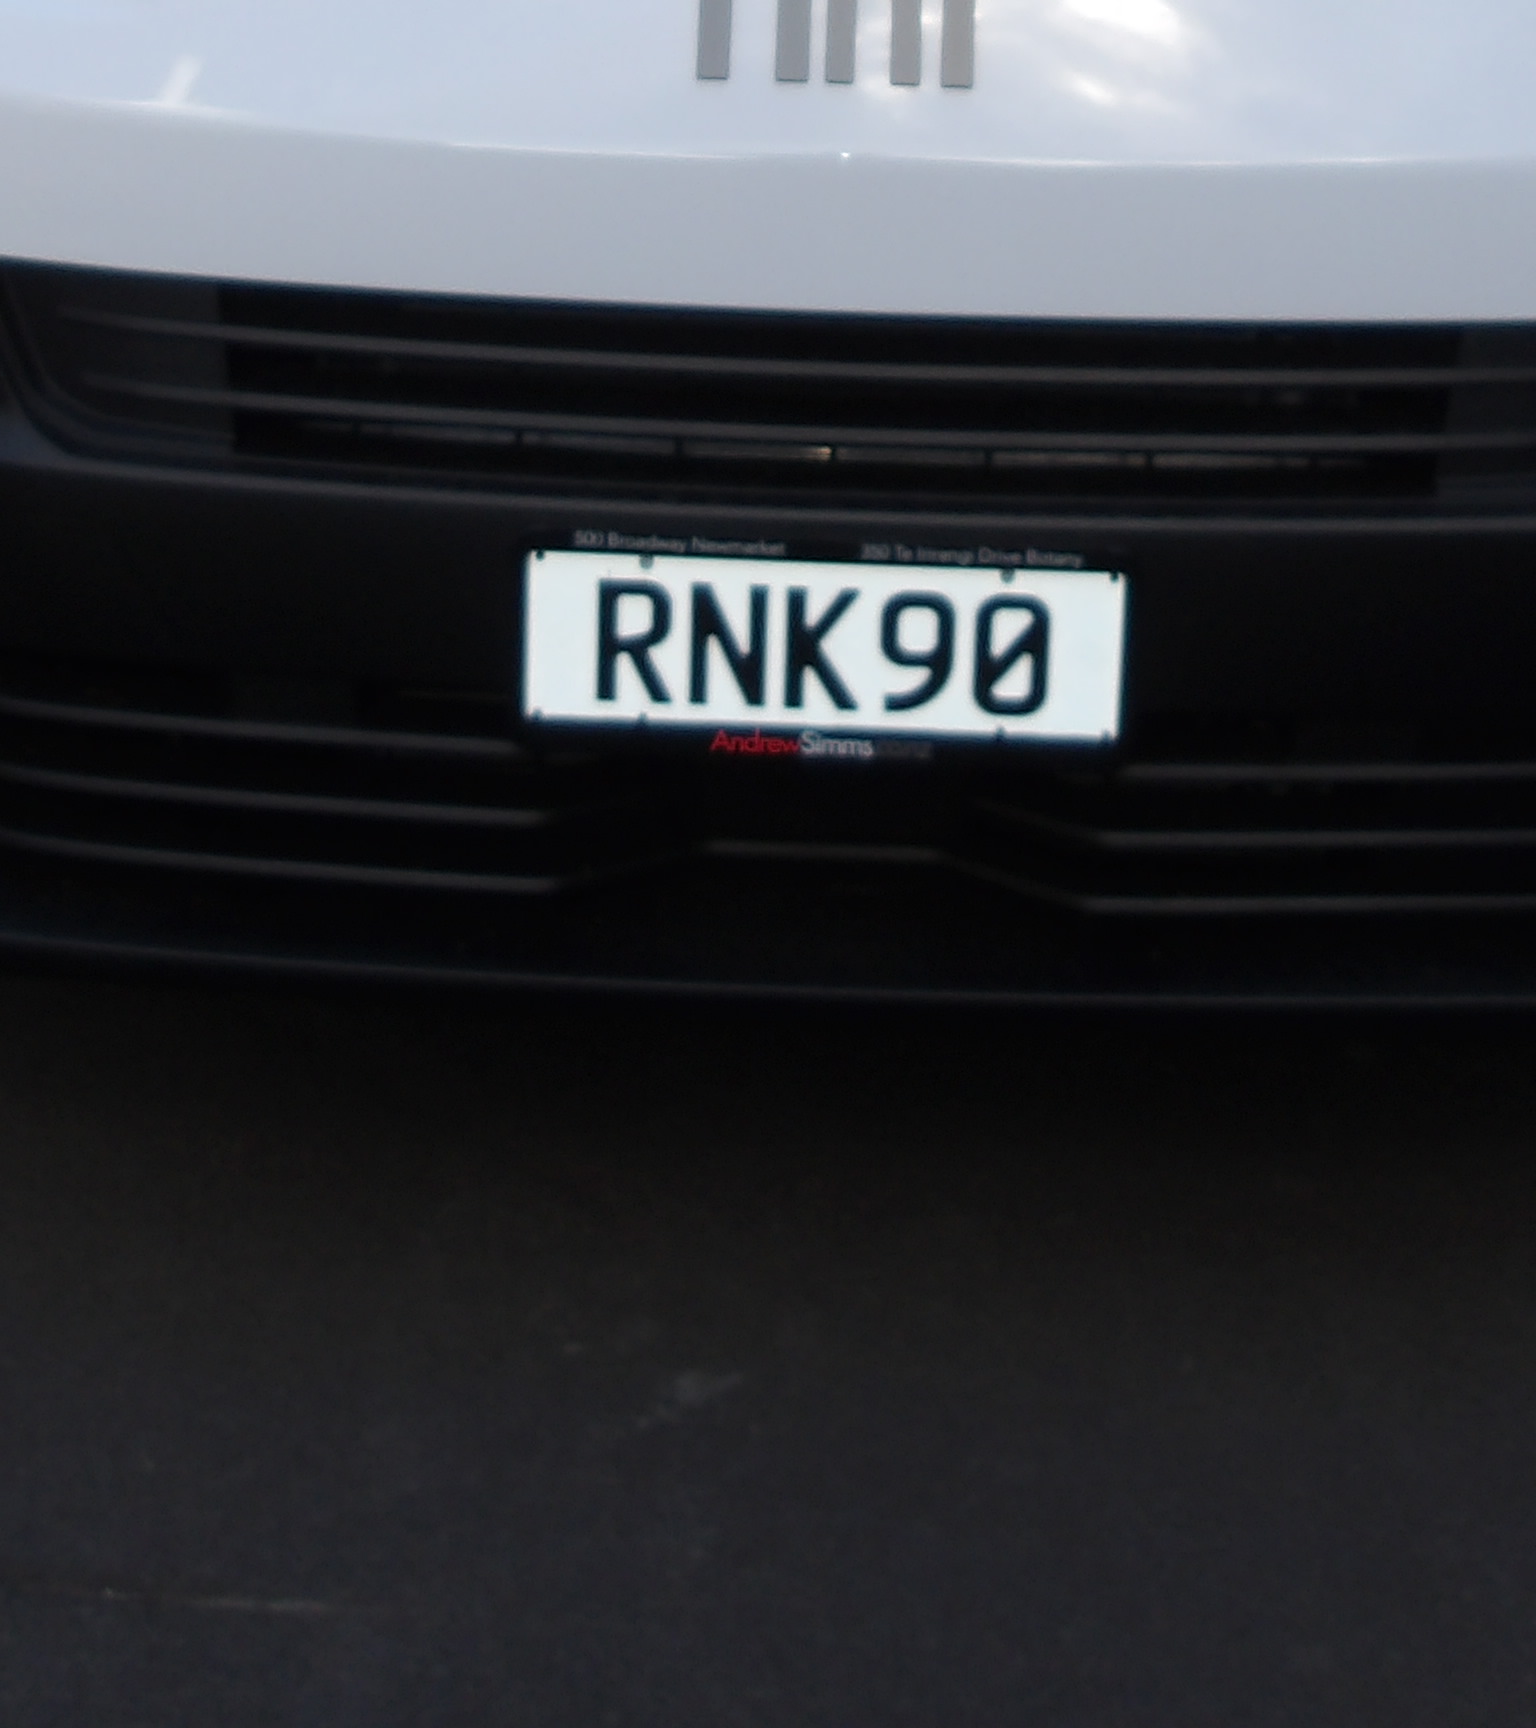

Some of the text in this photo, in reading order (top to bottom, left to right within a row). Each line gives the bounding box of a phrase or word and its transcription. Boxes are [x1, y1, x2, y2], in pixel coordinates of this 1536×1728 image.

[607, 531, 686, 553] Broadway
[691, 536, 786, 556] Newmarket
[978, 546, 1022, 565] Drive
[595, 577, 1051, 717] RNK90
